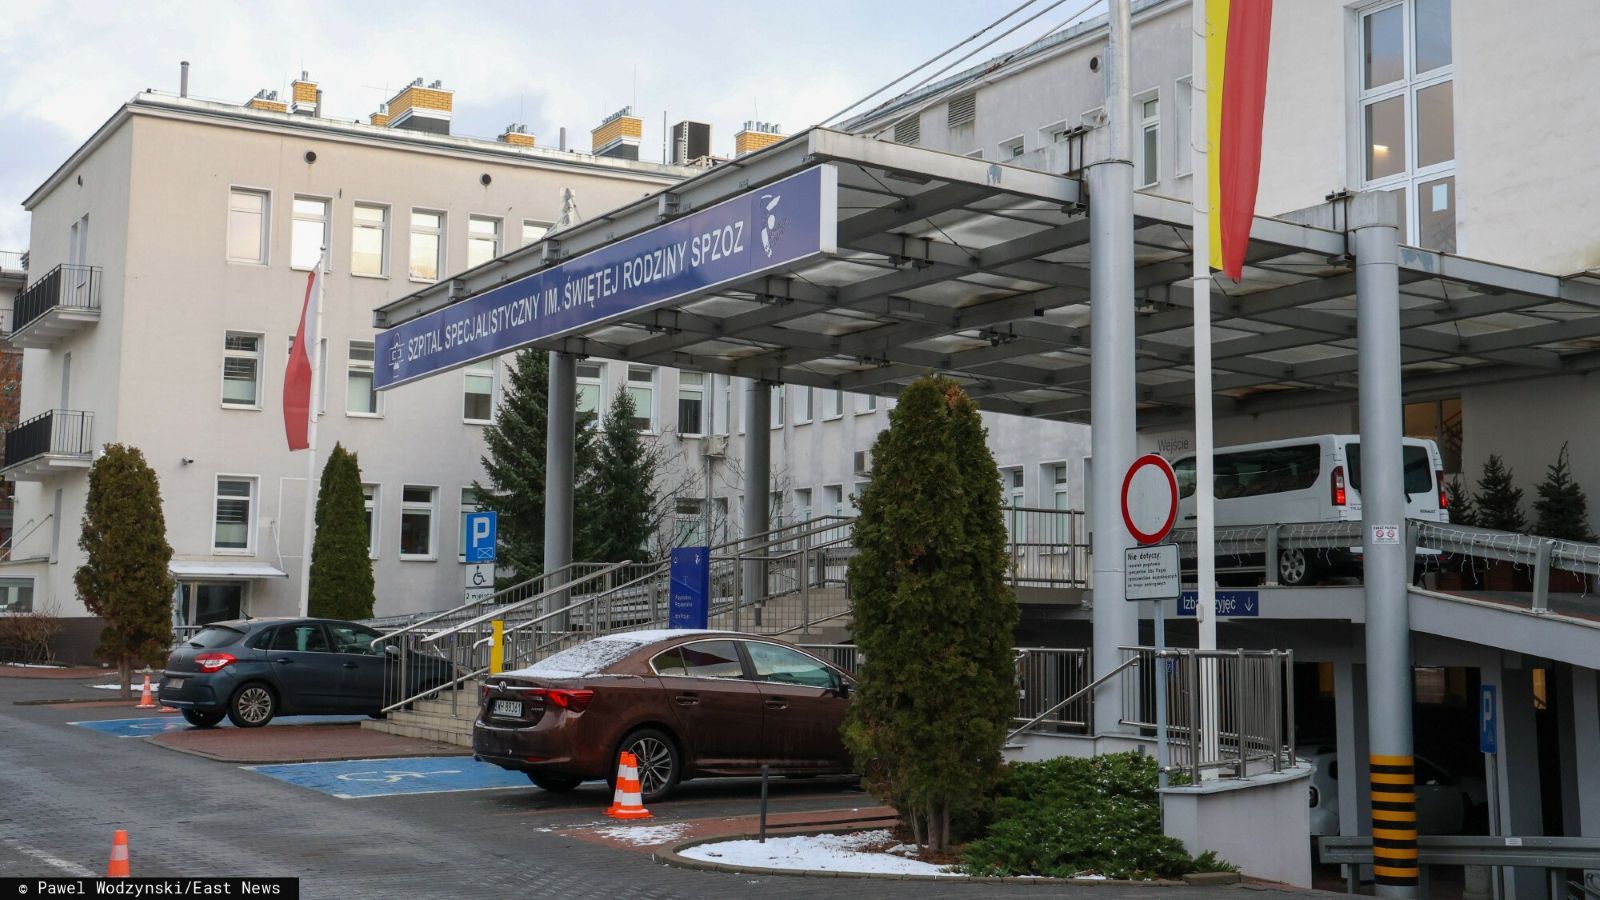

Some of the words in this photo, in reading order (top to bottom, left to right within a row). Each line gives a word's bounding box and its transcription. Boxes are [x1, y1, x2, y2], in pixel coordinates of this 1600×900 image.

[408, 328, 443, 362] SZPITAL
[445, 293, 540, 349] SPECJALISTYCZNY
[544, 287, 560, 317] IM.
[564, 260, 618, 310] ŚWIĘTEJ
[623, 241, 687, 290] RODZINY
[691, 220, 744, 268] SPZOZ
[1158, 438, 1189, 454] Wejście
[473, 517, 490, 548] P
[1483, 691, 1492, 732] P
